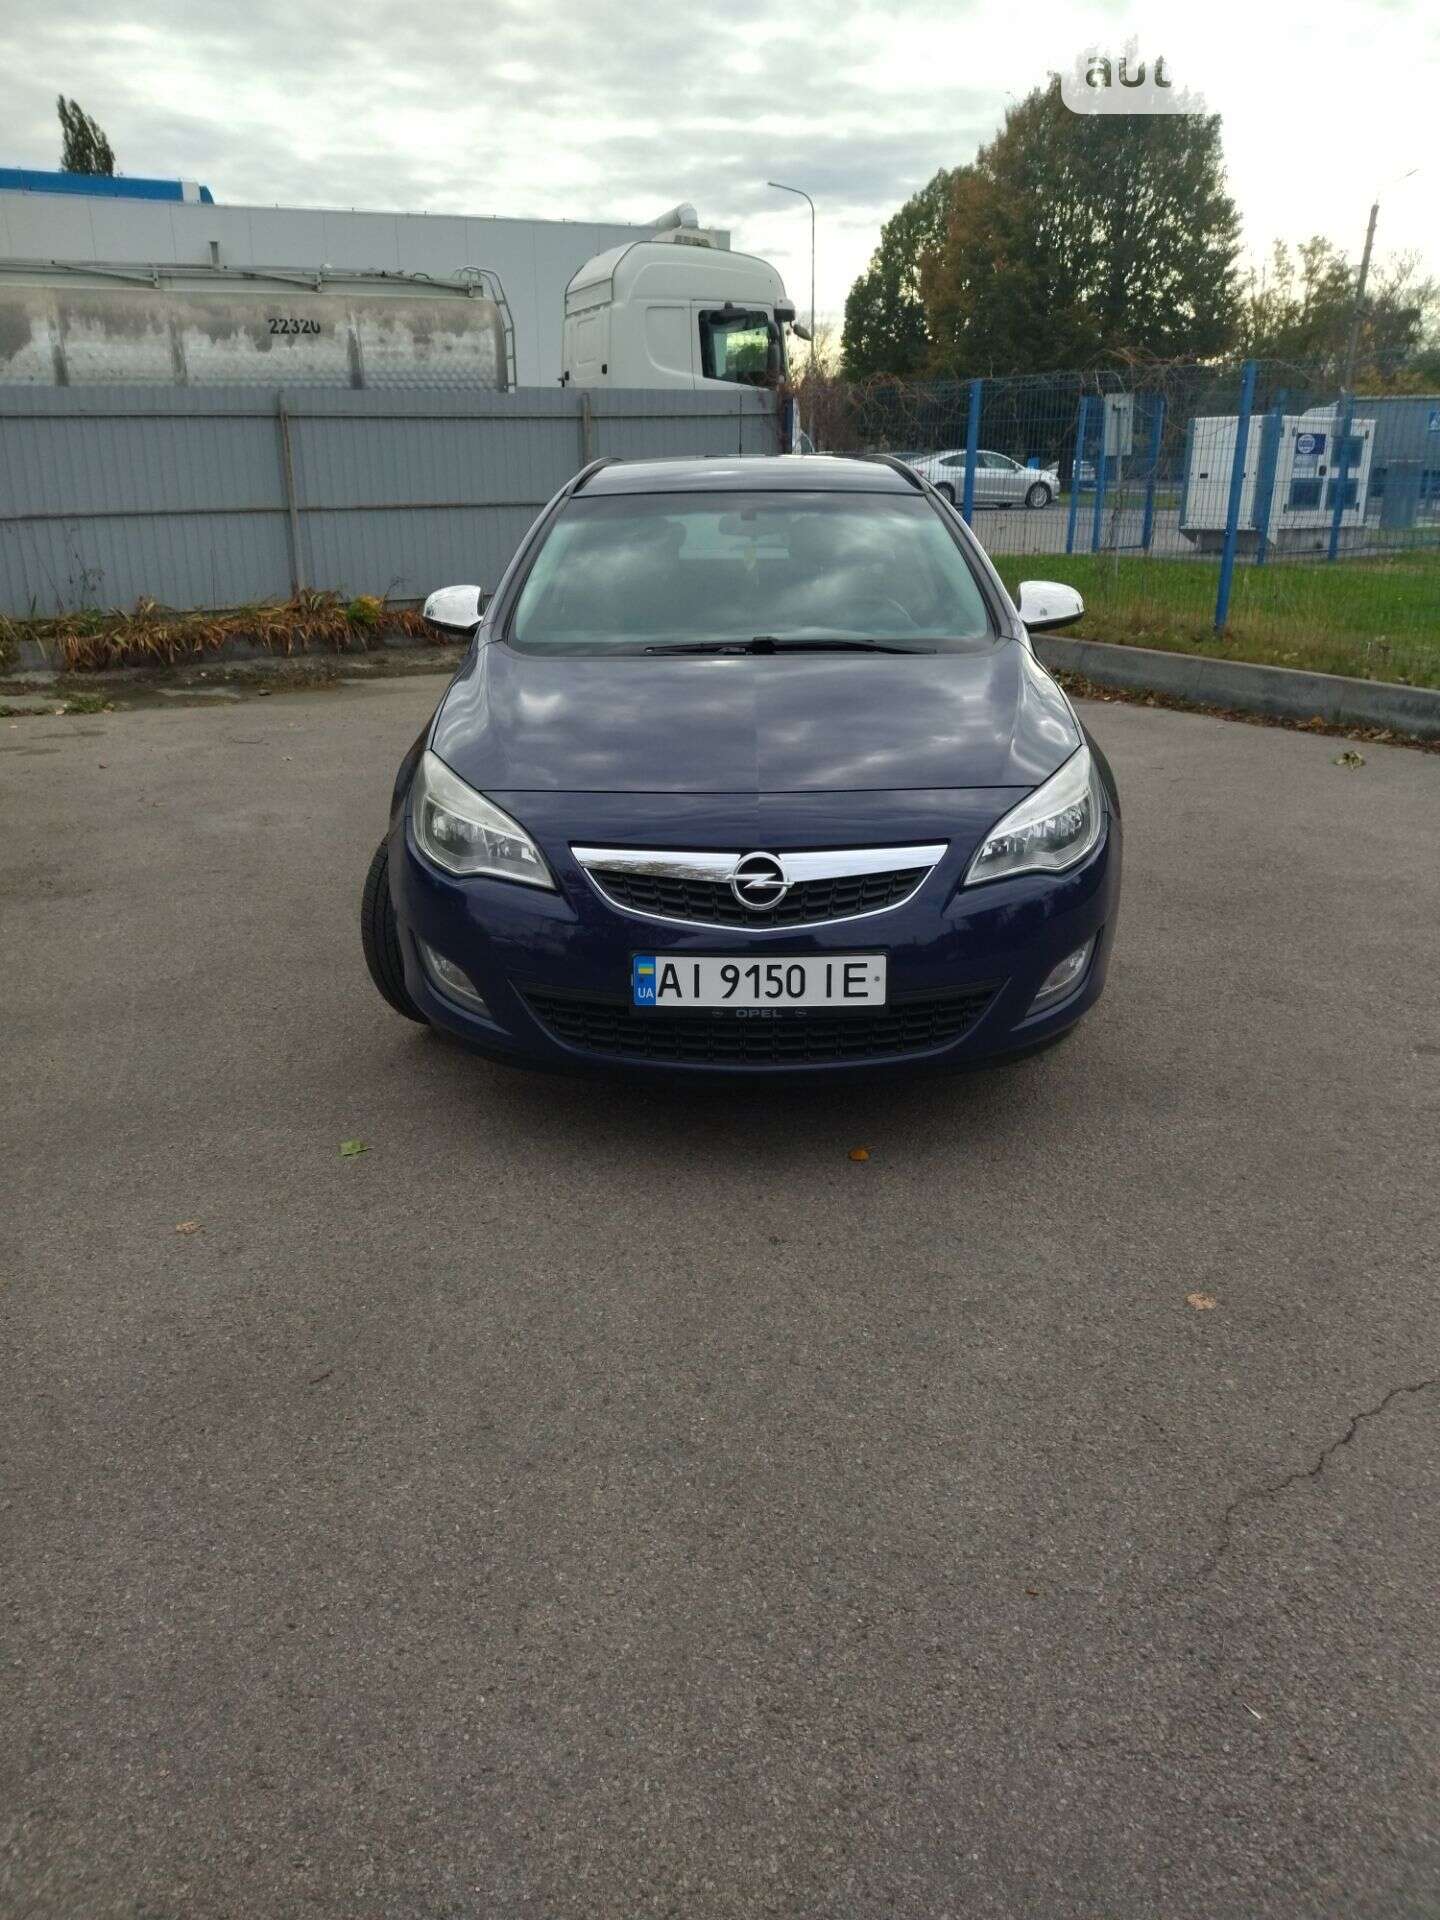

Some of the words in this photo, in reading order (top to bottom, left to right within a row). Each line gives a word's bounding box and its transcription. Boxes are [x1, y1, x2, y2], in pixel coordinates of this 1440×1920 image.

[657, 963, 700, 999] AI
[720, 963, 806, 999] 9150
[826, 962, 869, 998] IE
[638, 987, 654, 999] UA
[735, 1008, 783, 1018] OPEL
